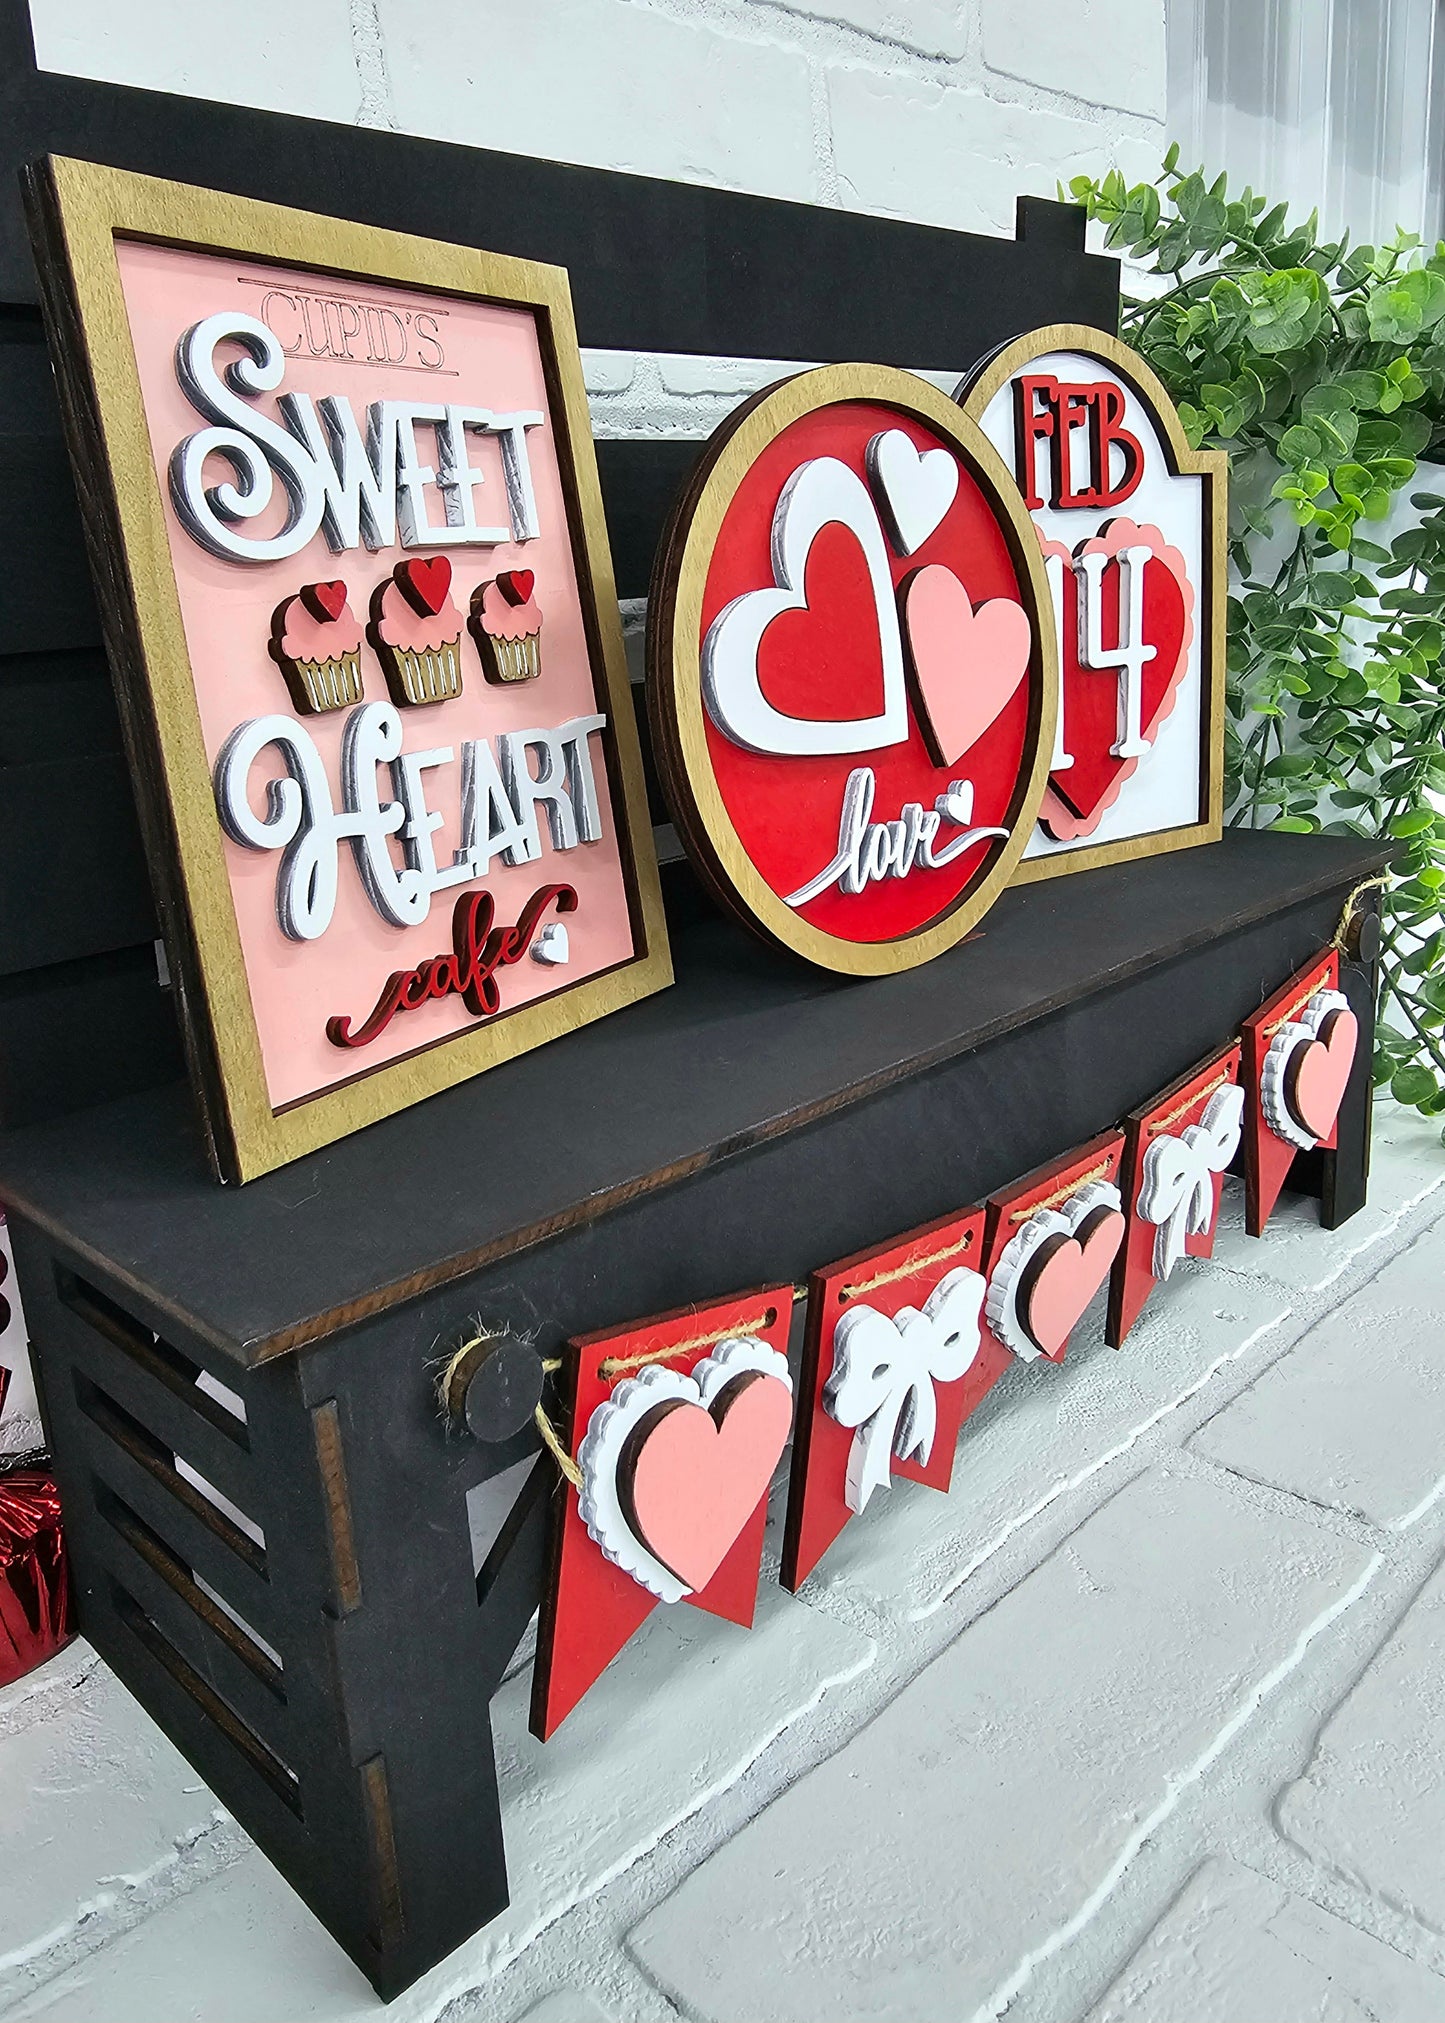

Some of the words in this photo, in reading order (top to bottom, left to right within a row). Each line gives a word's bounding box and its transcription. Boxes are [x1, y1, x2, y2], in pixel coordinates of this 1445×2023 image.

[261, 291, 445, 370] CUPID'S
[169, 312, 544, 562] SWEET
[1011, 375, 1144, 511] FEB
[1043, 545, 1157, 770] 14
[213, 701, 607, 941] HEART
[784, 767, 1010, 907] love
[325, 884, 579, 1048] cafe
